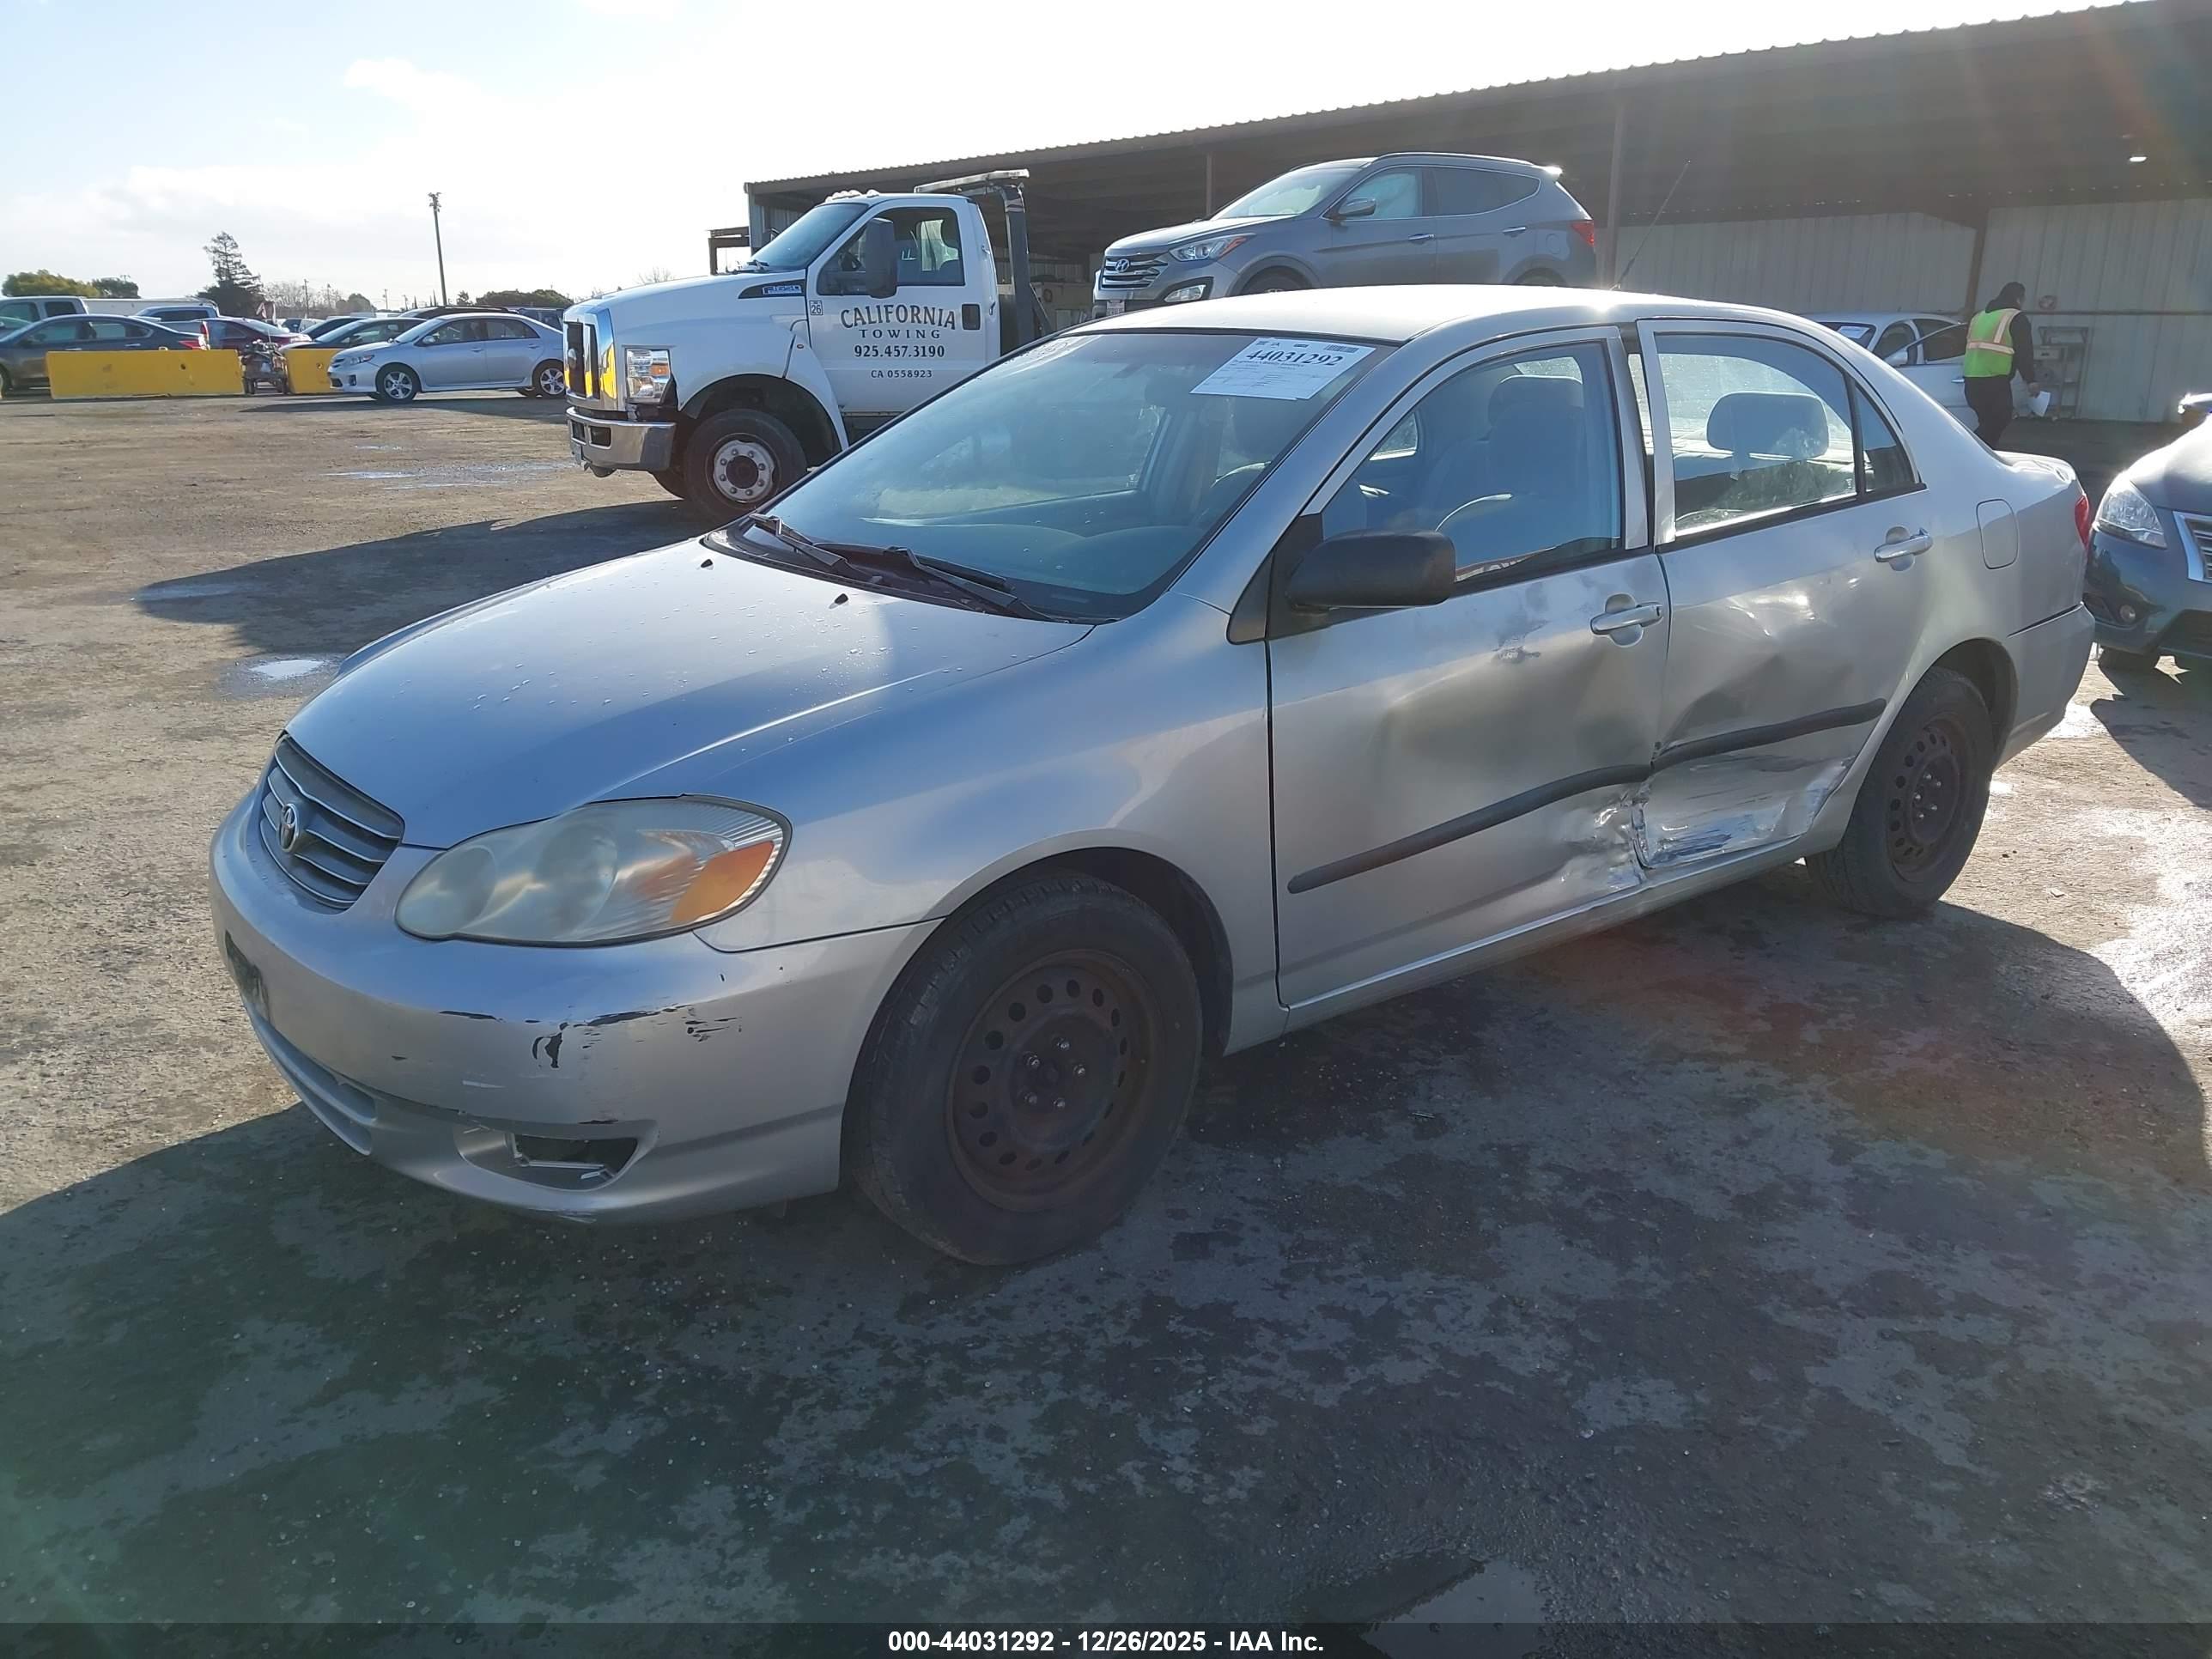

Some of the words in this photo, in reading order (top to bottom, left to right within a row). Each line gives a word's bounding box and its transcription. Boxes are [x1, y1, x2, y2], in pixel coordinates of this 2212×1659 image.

[811, 304, 822, 314] 26
[841, 304, 956, 330] CALIFORNIA
[859, 329, 940, 339] TOWING
[854, 345, 945, 357] 925.457.3190
[1246, 349, 1343, 366] 44031292
[871, 369, 884, 378] CA
[887, 369, 933, 378] 0558923
